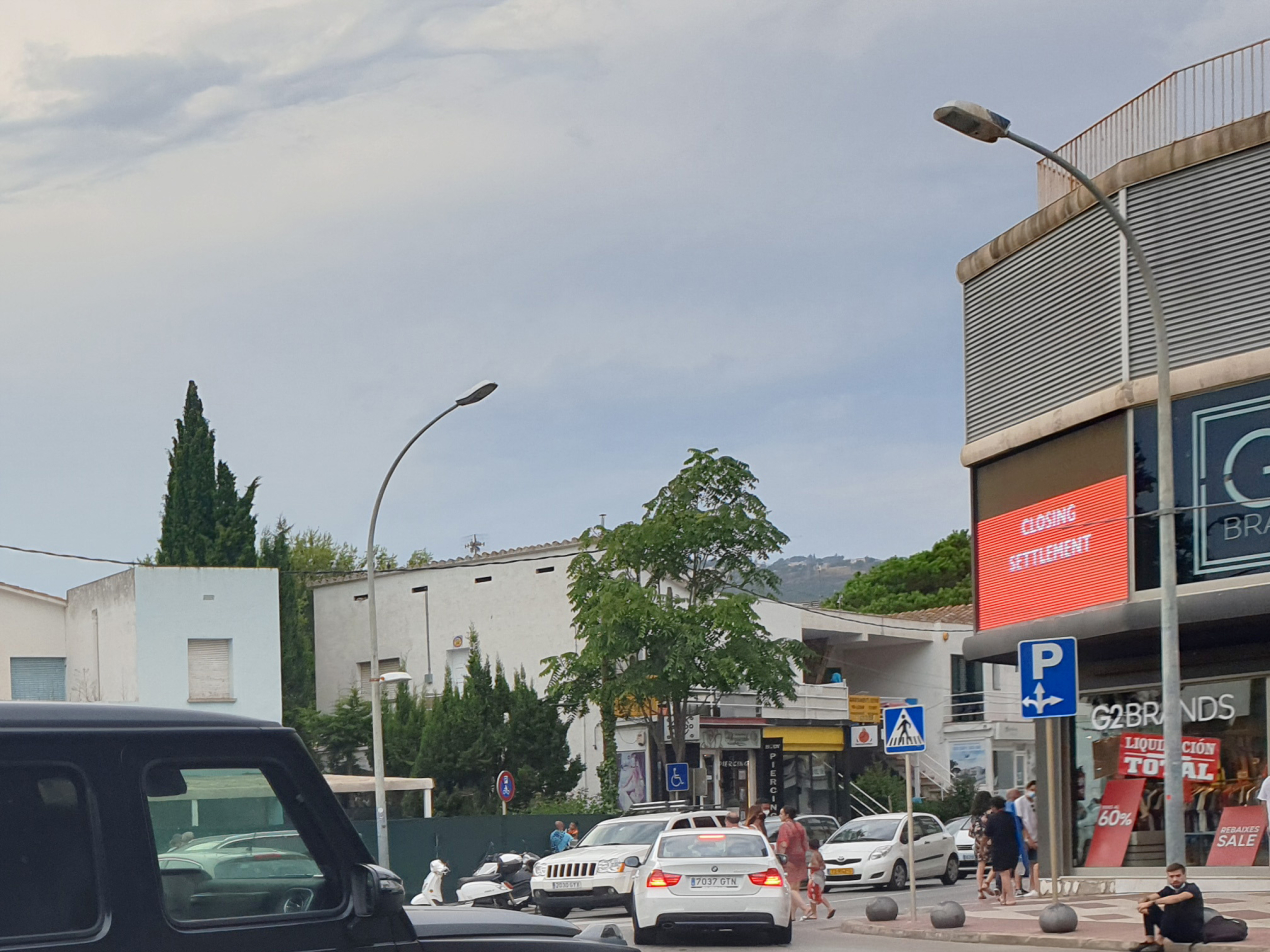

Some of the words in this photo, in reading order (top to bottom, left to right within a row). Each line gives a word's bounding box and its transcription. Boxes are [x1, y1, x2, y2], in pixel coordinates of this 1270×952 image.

[1020, 503, 1076, 536] CLOSING
[1009, 534, 1092, 574] SETTLEMENT
[1032, 643, 1063, 680] P
[1091, 694, 1236, 731] G2BRNDS
[1124, 737, 1216, 756] LIQUICIÓN
[1123, 756, 1215, 781] TOAL
[1098, 810, 1133, 827] 60%
[1217, 834, 1258, 847] SALE
[1220, 826, 1260, 834] REBAIXES
[696, 877, 717, 886] 7037
[720, 877, 737, 886] GTN
